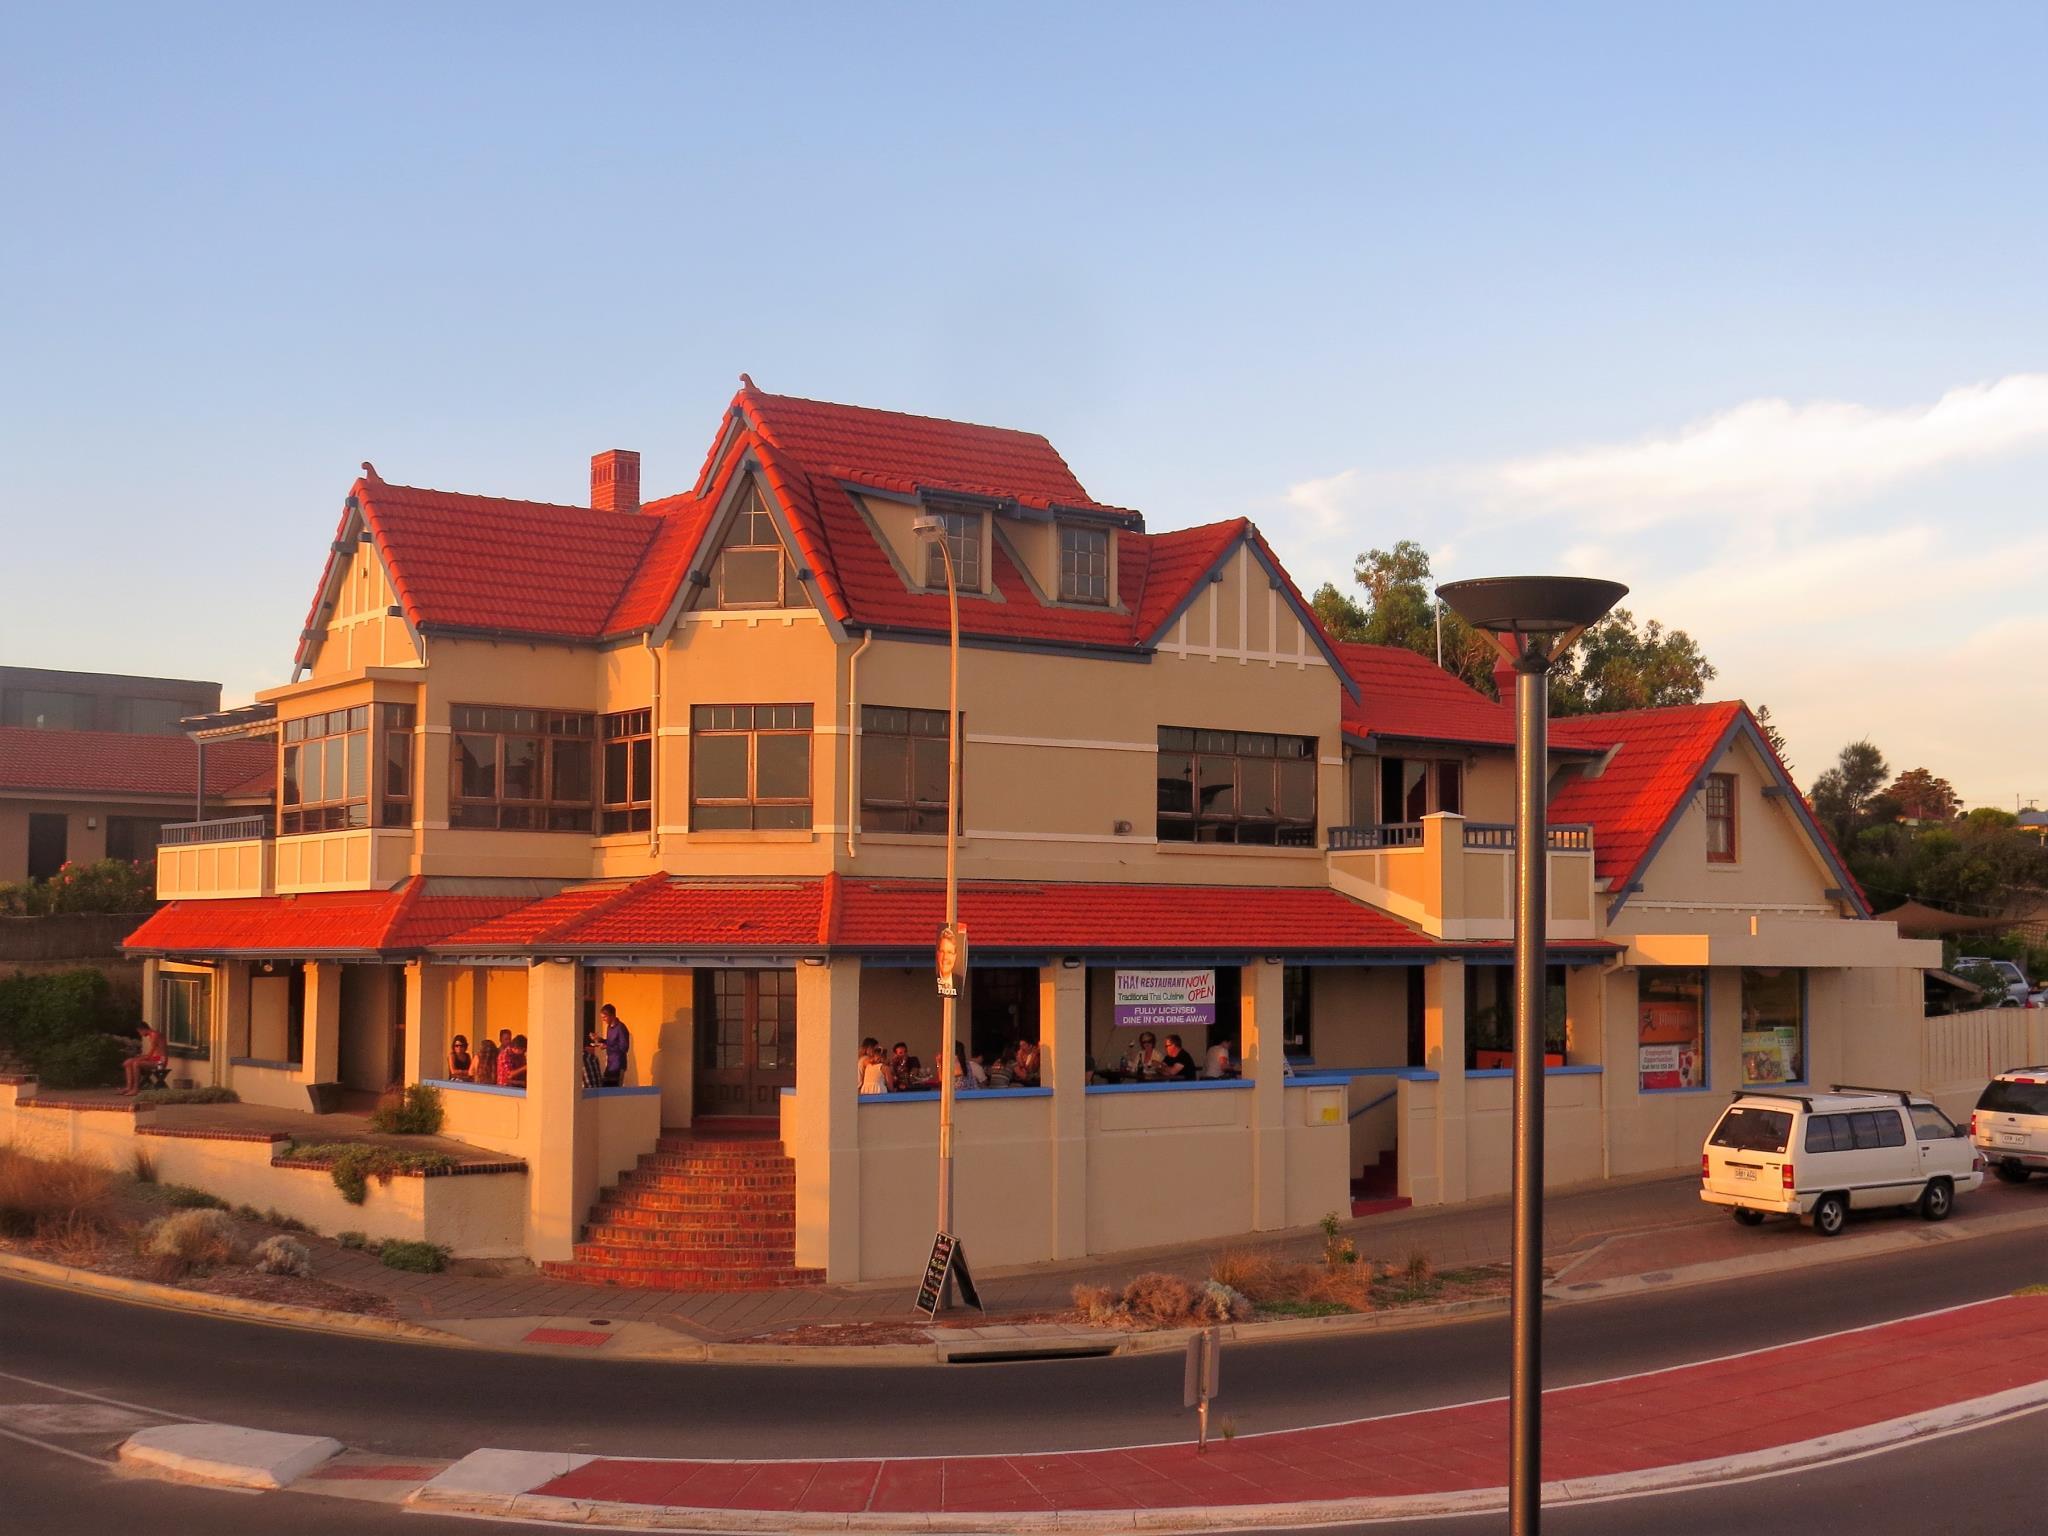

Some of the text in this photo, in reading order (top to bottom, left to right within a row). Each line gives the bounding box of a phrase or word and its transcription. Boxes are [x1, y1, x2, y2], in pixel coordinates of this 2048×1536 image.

[1117, 975, 1185, 989] THAI RESTAURANT
[1186, 973, 1209, 989] NOW
[1118, 992, 1184, 1001] Traditional Thai Cuisine
[1188, 986, 1214, 1001] OPEN
[1134, 1006, 1196, 1015] FULLY LICENSED
[1123, 1015, 1207, 1024] DINE IN OR DINE AWAY
